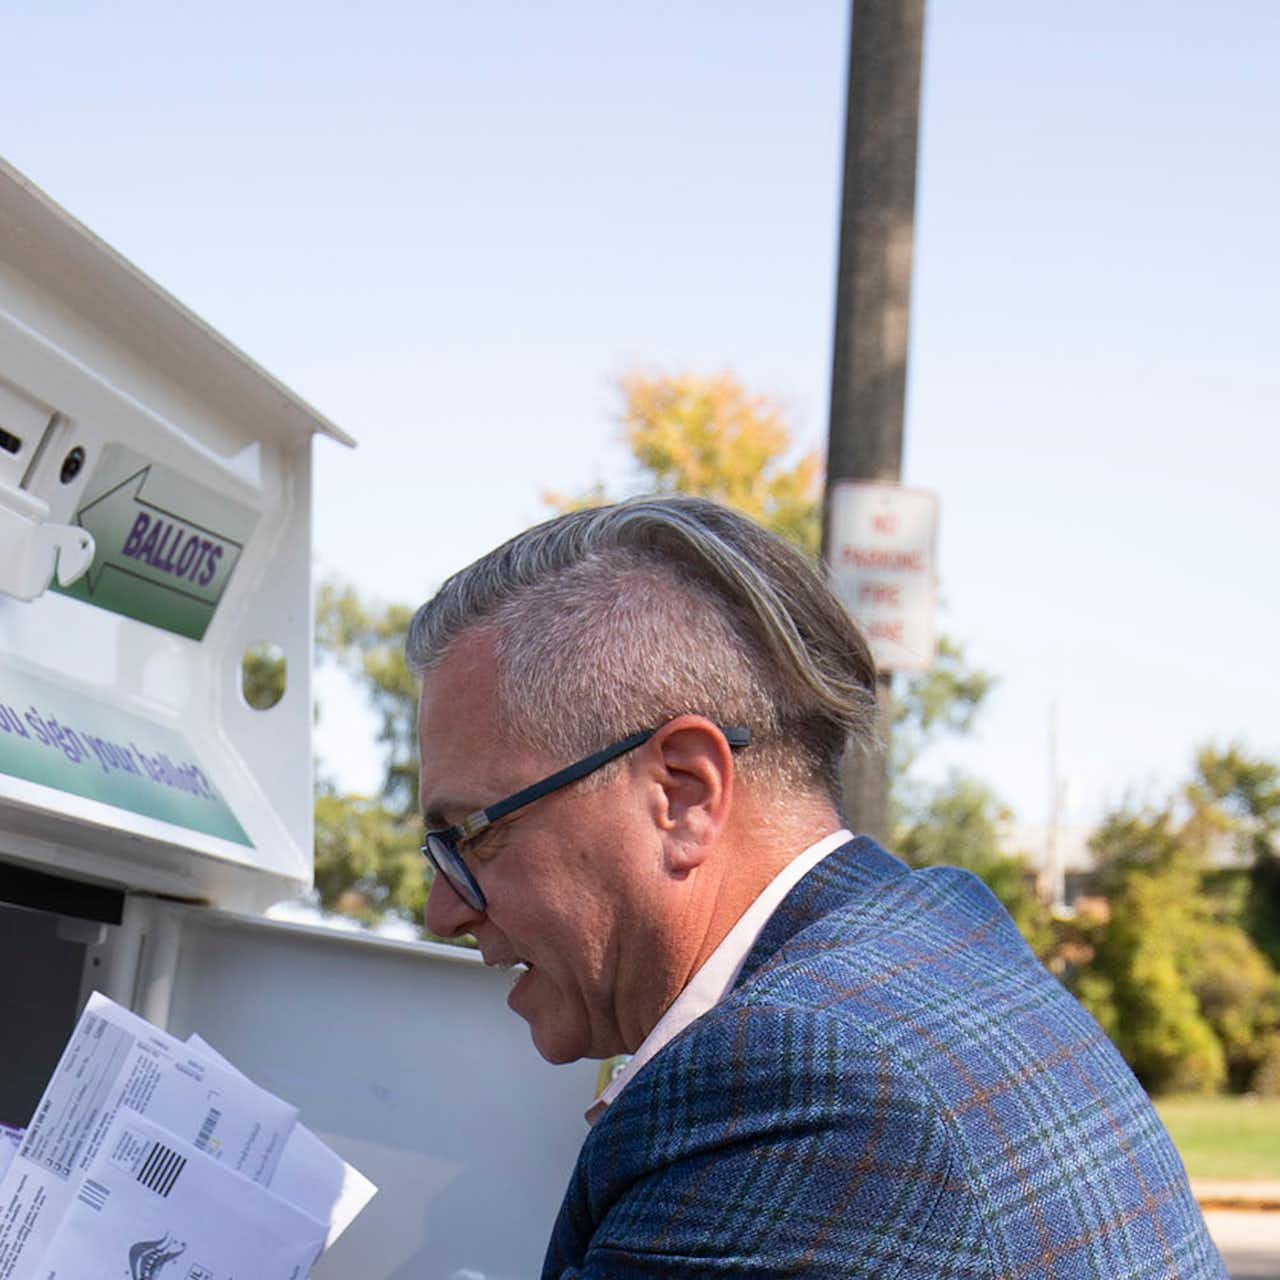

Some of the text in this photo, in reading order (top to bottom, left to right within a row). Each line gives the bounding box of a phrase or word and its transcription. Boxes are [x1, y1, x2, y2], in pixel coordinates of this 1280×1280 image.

[122, 512, 223, 586] BALLOTS
[24, 706, 90, 763] sign
[81, 732, 141, 775] your
